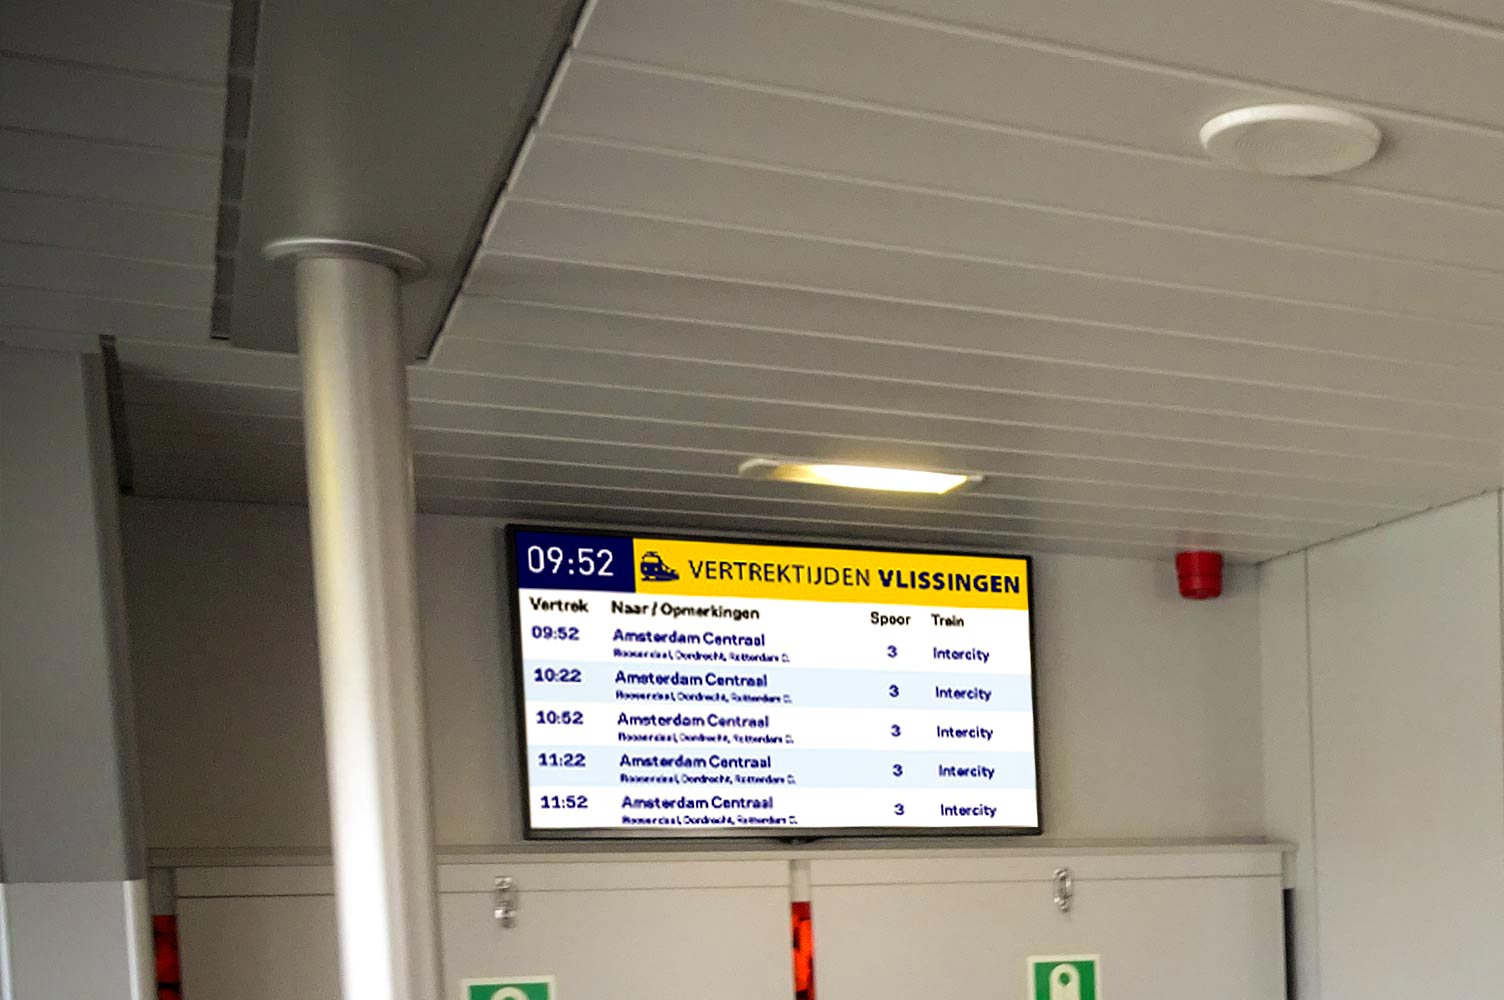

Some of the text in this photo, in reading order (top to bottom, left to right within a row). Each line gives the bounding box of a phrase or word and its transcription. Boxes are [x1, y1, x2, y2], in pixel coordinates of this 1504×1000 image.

[528, 545, 614, 576] 09:52
[688, 560, 1020, 594] VERTREKTIJDEN VLISSINGEN
[530, 596, 589, 613] Vertrek
[611, 600, 648, 616] Naar
[660, 602, 760, 621] Opmerkingen
[870, 611, 912, 626] Spoor
[532, 625, 989, 663] 09:52 Amsterdam Centraal 3 Intercity
[534, 668, 992, 702] 10:22 Amsterdam Centraal 3 Intercity
[536, 710, 993, 740] 10:52 Amsterdam Centraal 3 Intercity
[538, 753, 995, 780] 11:22 Amsterdam Centraal 3 Intercity
[541, 795, 997, 818] 11:52 Amsterdam Centraal 3 Intercity
